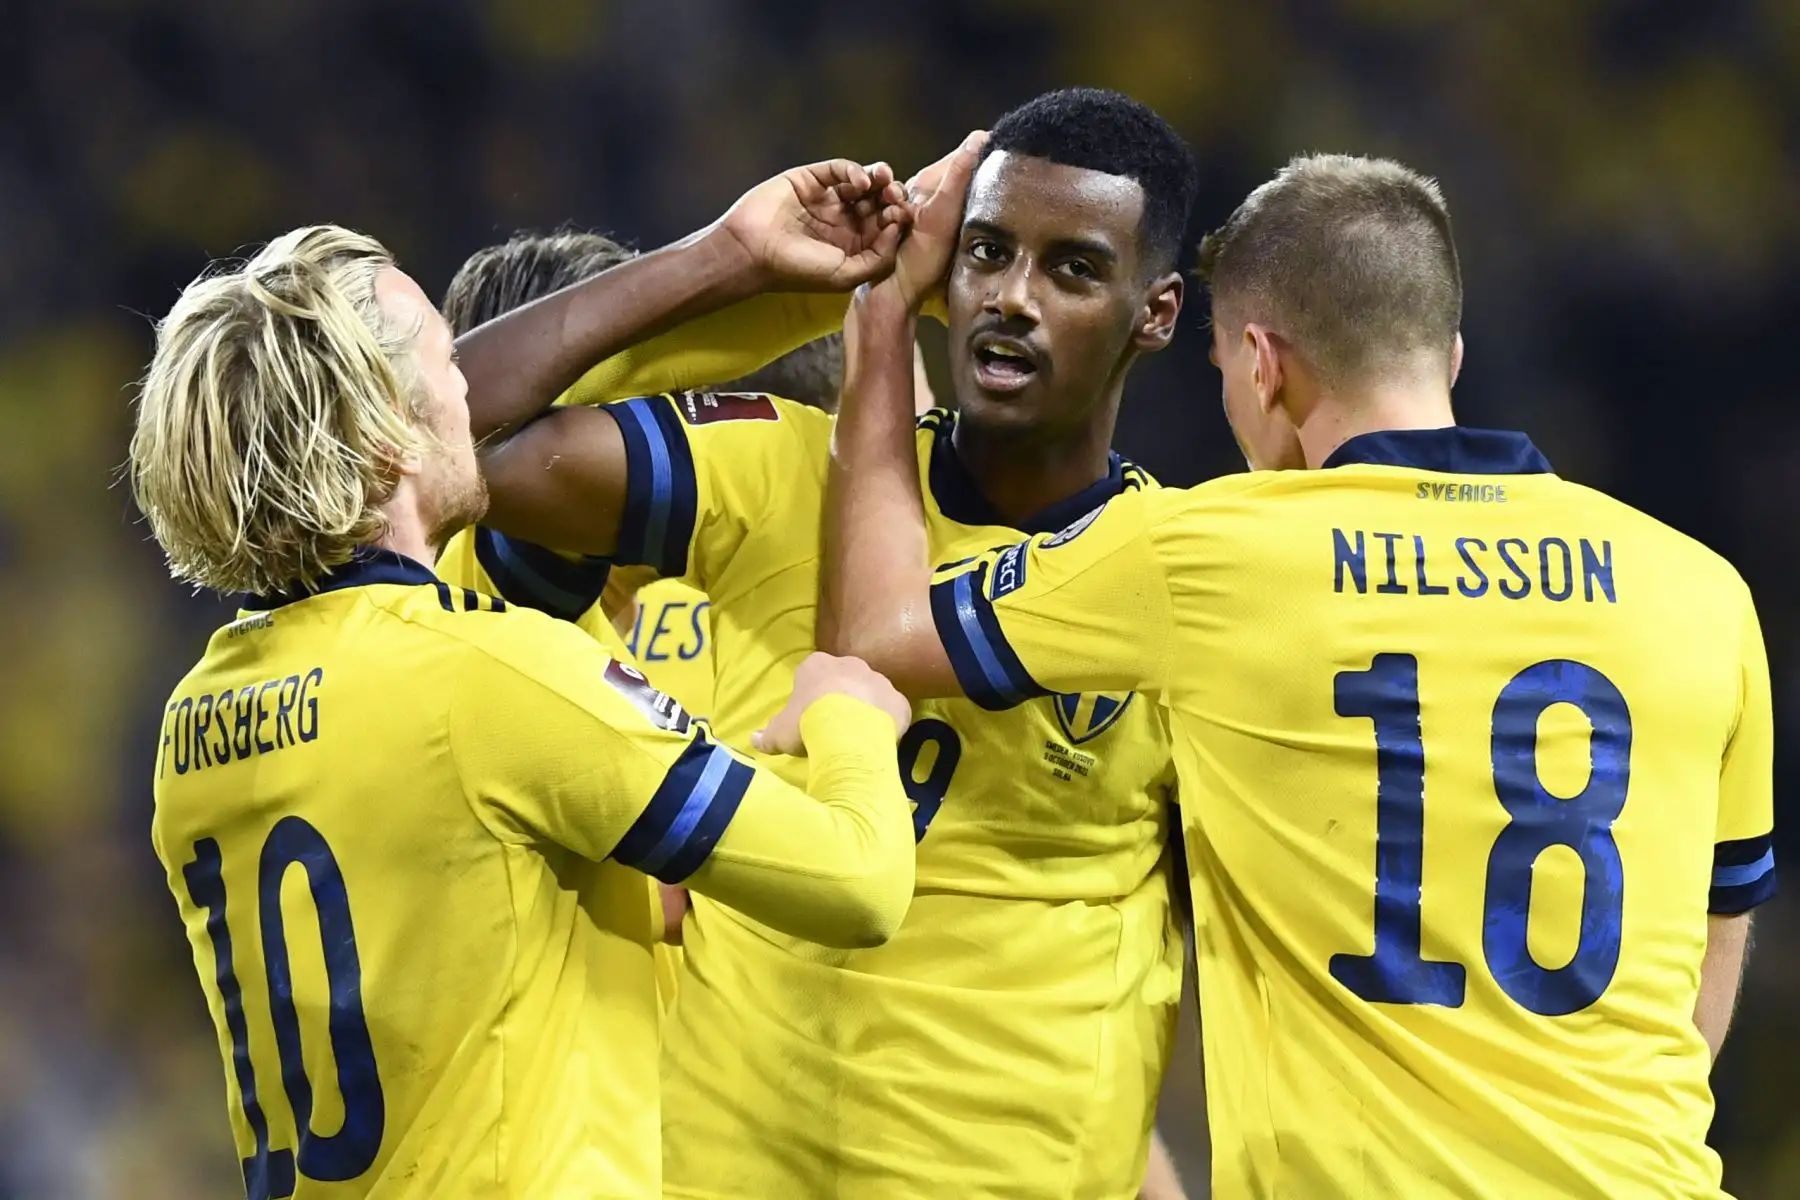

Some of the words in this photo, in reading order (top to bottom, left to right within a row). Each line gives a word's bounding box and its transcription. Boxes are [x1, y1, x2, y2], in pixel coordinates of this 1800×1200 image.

[1416, 482, 1508, 503] SVERIGE
[1332, 527, 1617, 603] NILSSON
[160, 667, 323, 779] FORSBERG
[897, 718, 962, 845] 9
[1329, 652, 1633, 1016] 18
[182, 816, 385, 1200] 10
